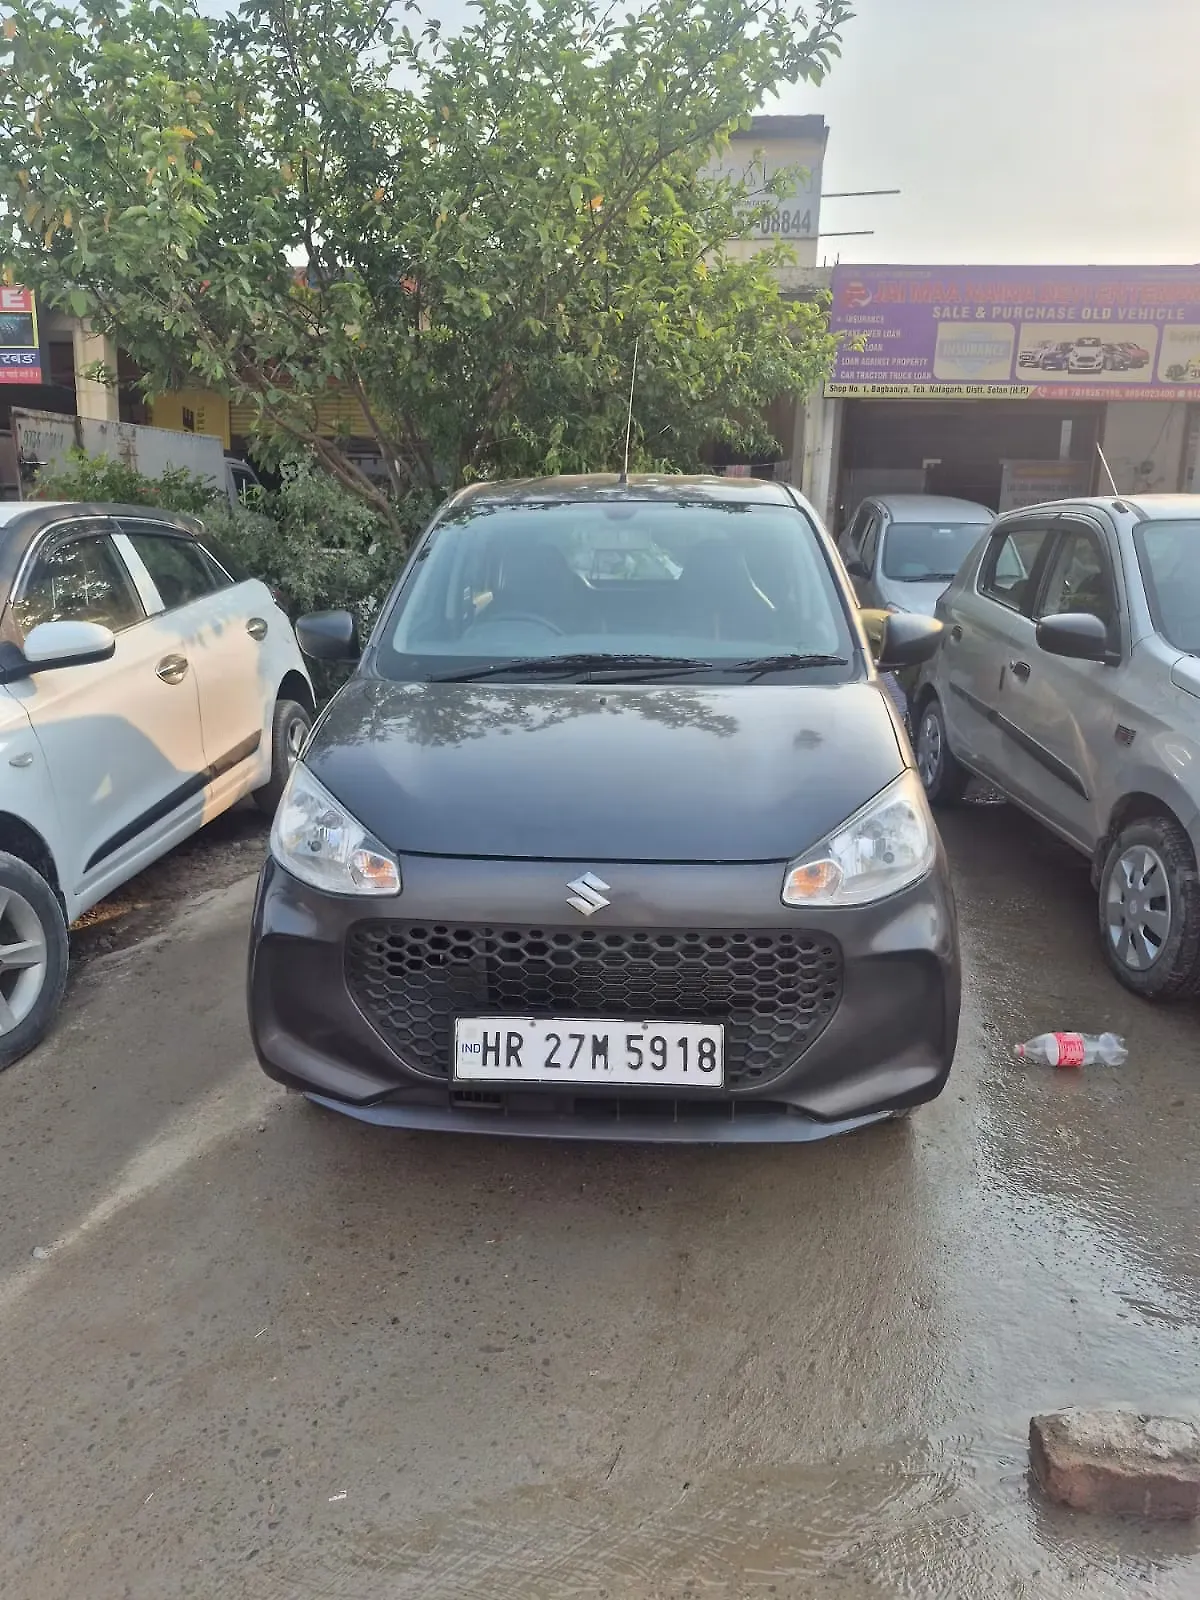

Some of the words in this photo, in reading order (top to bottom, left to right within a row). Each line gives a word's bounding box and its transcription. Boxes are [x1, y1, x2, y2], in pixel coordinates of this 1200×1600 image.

[932, 306, 971, 319] SALE
[975, 306, 986, 319] &
[991, 306, 1076, 320] PURCHASE
[1081, 308, 1112, 320] OLD
[1117, 308, 1185, 321] VEHICLE
[845, 315, 884, 323] INSURANCE
[883, 329, 901, 338] LOAN
[865, 343, 883, 351] LOAN
[943, 342, 1005, 357] INSURANCE
[842, 358, 859, 366] LOAN
[861, 358, 890, 366] AGAINST
[891, 358, 928, 366] PROPERTY
[840, 371, 854, 379] CAR
[856, 371, 887, 379] TRACTOR
[890, 371, 912, 379] TRUCK
[914, 371, 932, 379] LOAN
[829, 384, 847, 393] Shop
[849, 384, 859, 393] No.
[461, 1043, 481, 1054] IND
[481, 1031, 524, 1068] HR
[544, 1033, 609, 1070] 27M
[625, 1034, 717, 1073] 5918
